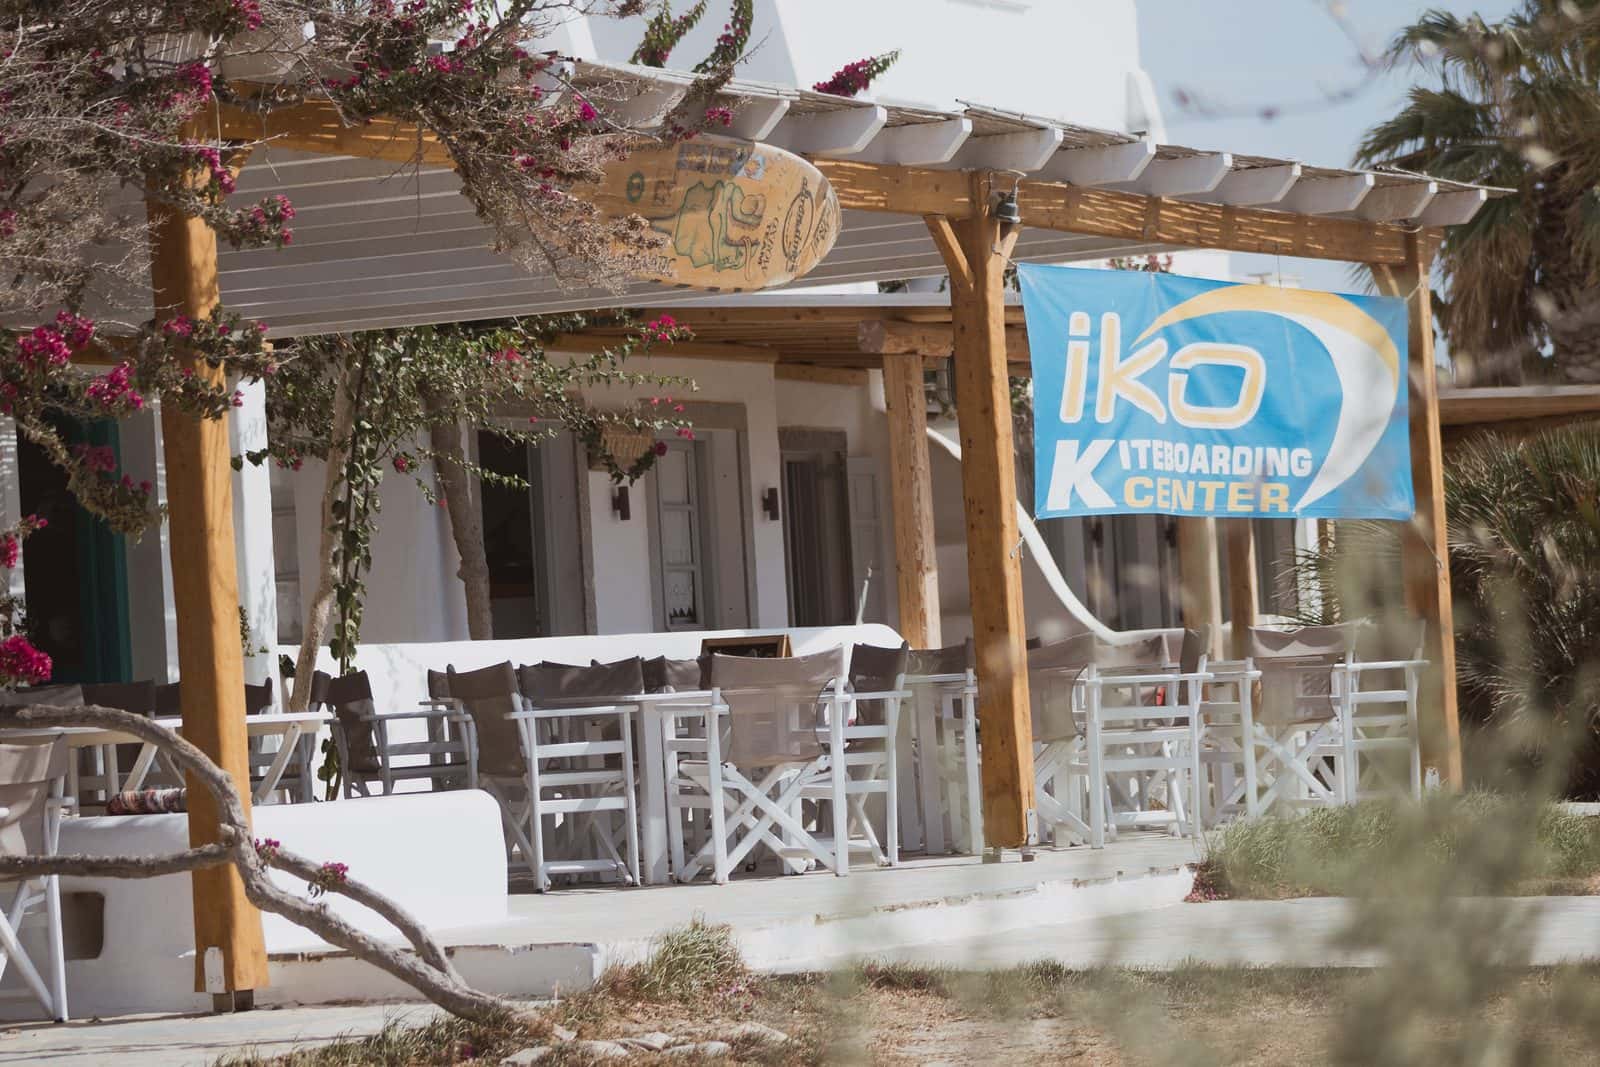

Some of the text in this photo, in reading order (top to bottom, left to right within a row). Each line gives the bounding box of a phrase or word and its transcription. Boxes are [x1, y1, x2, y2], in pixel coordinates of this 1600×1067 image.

[1059, 311, 1267, 429] iko
[1046, 439, 1313, 511] KITEBOARDING
[1123, 476, 1290, 513] CENTER
